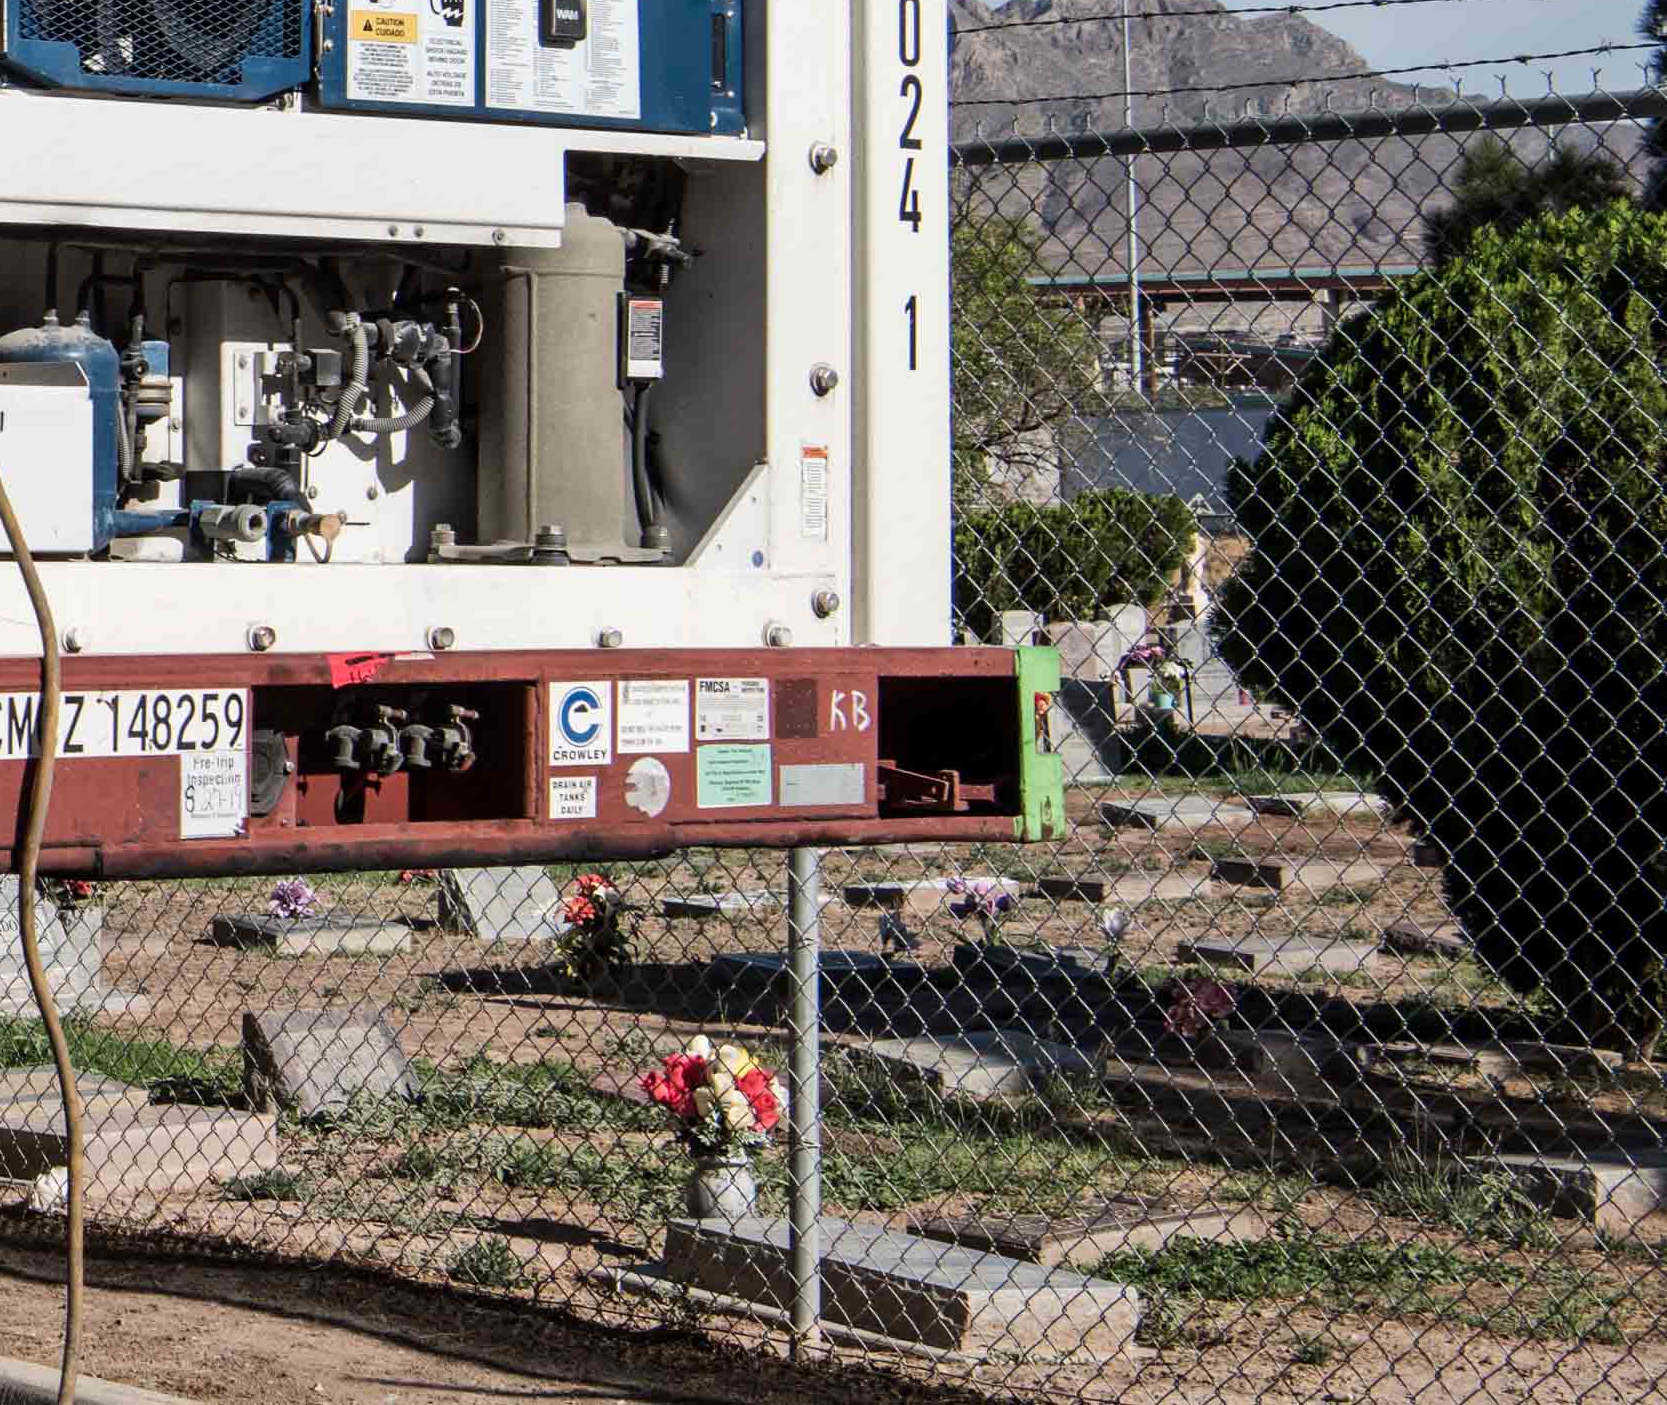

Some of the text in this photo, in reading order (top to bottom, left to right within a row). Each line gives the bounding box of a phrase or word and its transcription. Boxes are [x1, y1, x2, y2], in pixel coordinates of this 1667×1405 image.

[375, 17, 405, 27] CAUTION
[375, 28, 406, 38] CUIDADO
[699, 680, 731, 693] FMCSA
[105, 693, 244, 752] 148259
[553, 749, 607, 761] CROWLEY
[193, 756, 234, 771] Pre-Trip
[187, 774, 242, 788] Inspection
[552, 780, 592, 790] DRAIN AIR
[559, 793, 586, 802] TANKS
[560, 805, 583, 815] DAILY
